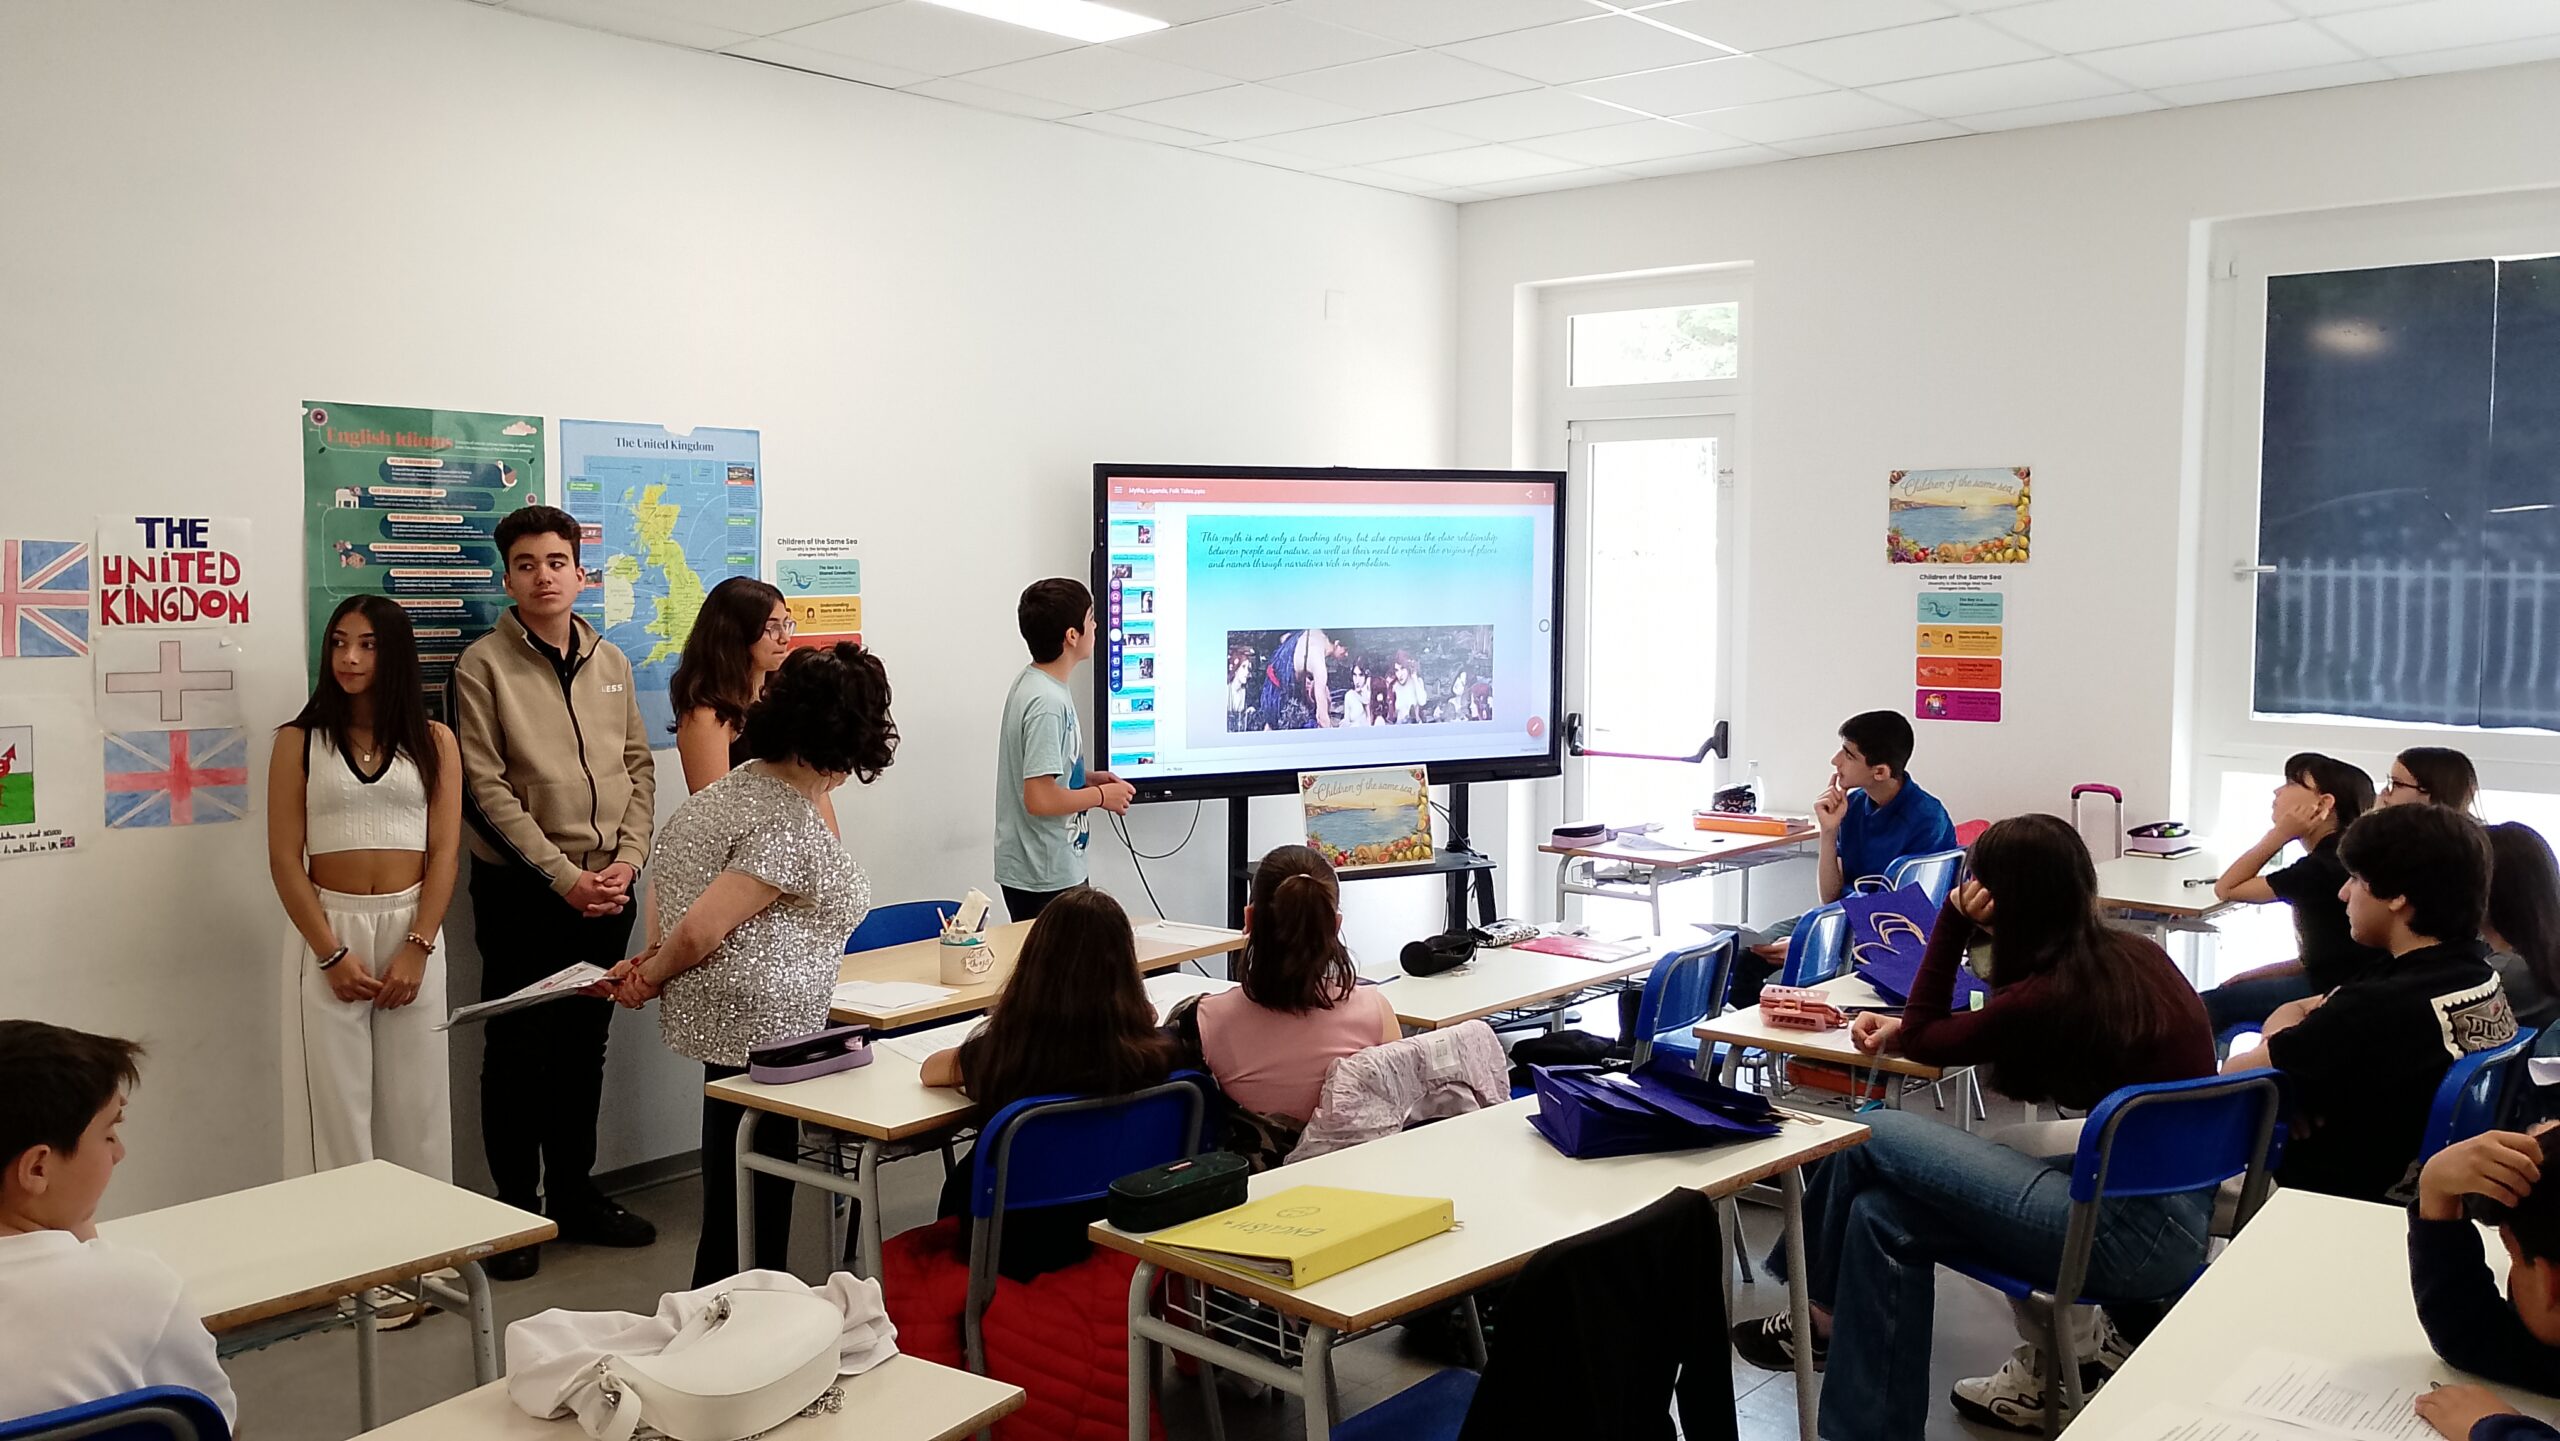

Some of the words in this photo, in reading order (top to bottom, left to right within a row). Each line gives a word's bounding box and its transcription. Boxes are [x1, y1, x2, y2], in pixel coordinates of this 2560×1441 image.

[327, 427, 391, 448] English
[395, 431, 454, 449] Idioms
[615, 437, 635, 448] The
[637, 438, 669, 450] United
[671, 440, 714, 453] Kingdom
[1901, 477, 1945, 496] Children
[1946, 475, 1956, 493] of
[1958, 475, 1972, 488] the
[1972, 480, 1996, 489] same
[1997, 483, 2017, 495] sea
[136, 517, 209, 549] THE
[1201, 531, 1219, 543] This
[1222, 532, 1242, 547] myth
[1245, 534, 1252, 543] is
[1255, 533, 1269, 543] not
[1271, 532, 1287, 545] only
[1290, 535, 1297, 543] a
[1298, 533, 1330, 545] touching
[1356, 532, 1369, 542] but
[1371, 533, 1386, 542] also
[1388, 535, 1421, 544] expresses
[1424, 532, 1436, 542] the
[1457, 532, 1499, 545] relationship
[1208, 545, 1239, 556] between
[1240, 546, 1265, 558] people
[1266, 546, 1282, 555] and
[1324, 545, 1340, 555] well
[1352, 545, 1370, 555] their
[1372, 545, 1389, 555] need
[1391, 545, 1398, 555] to
[1400, 545, 1426, 558] explain
[1428, 544, 1440, 555] the
[1441, 546, 1467, 558] origins
[1476, 545, 1497, 557] places
[1208, 559, 1224, 568] and
[1252, 558, 1282, 570] through
[1284, 559, 1323, 568] narratives
[1326, 558, 1340, 568] rich
[1341, 559, 1350, 568] in
[1313, 780, 1355, 801] Children
[1355, 778, 1364, 796] of
[1365, 778, 1380, 791] the
[1380, 782, 1399, 792] same
[1401, 785, 1416, 795] sea
